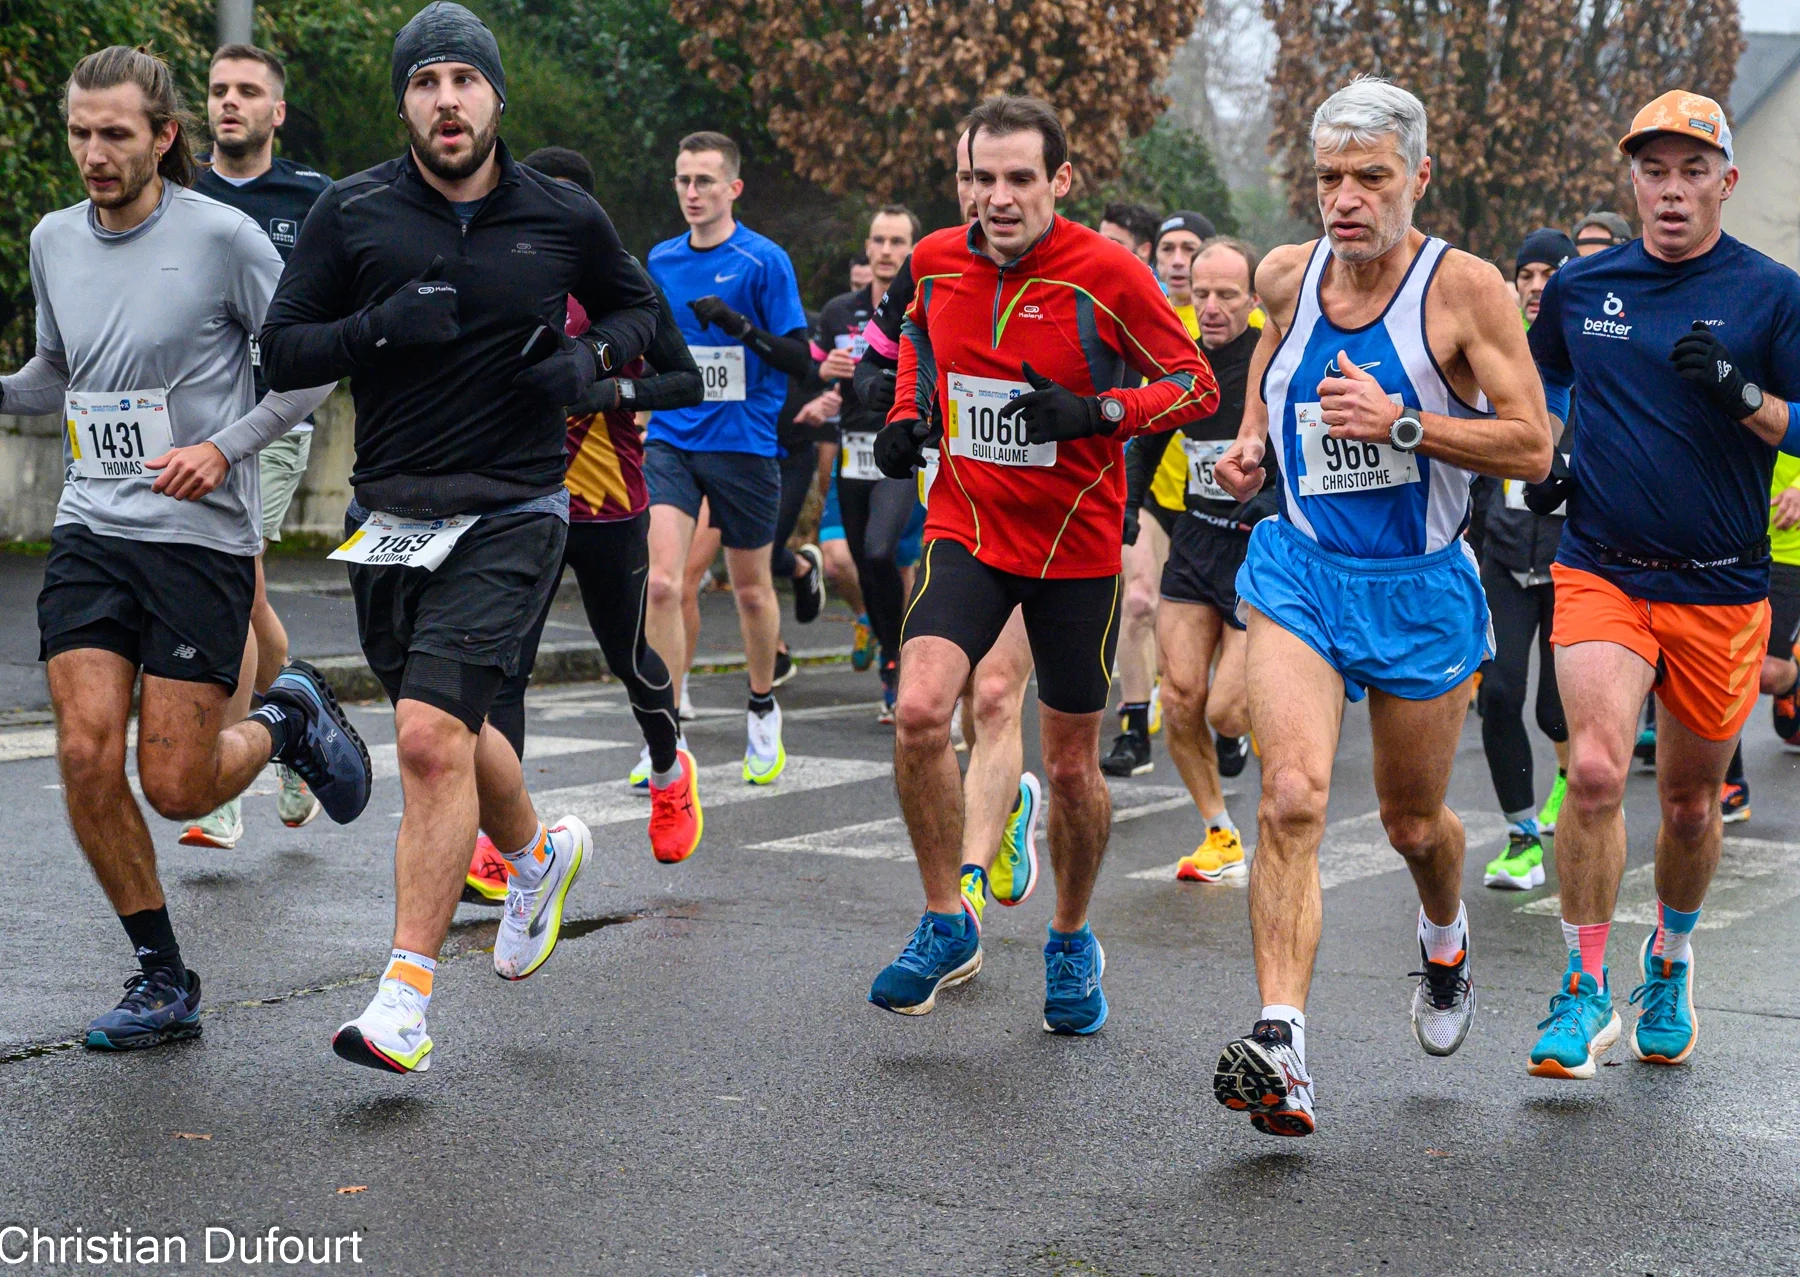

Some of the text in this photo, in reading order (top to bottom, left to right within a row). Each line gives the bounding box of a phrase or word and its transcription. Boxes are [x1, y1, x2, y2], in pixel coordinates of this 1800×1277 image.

[1583, 316, 1632, 336] better
[968, 406, 1030, 447] 1060
[88, 421, 145, 459] 1431
[972, 442, 1028, 463] GUILLAUME
[1321, 434, 1380, 472] 966
[101, 460, 143, 476] THOMAS
[1322, 469, 1391, 491] CHRISTOPHE
[369, 533, 437, 554] 1169
[364, 552, 414, 564] ANTOINE
